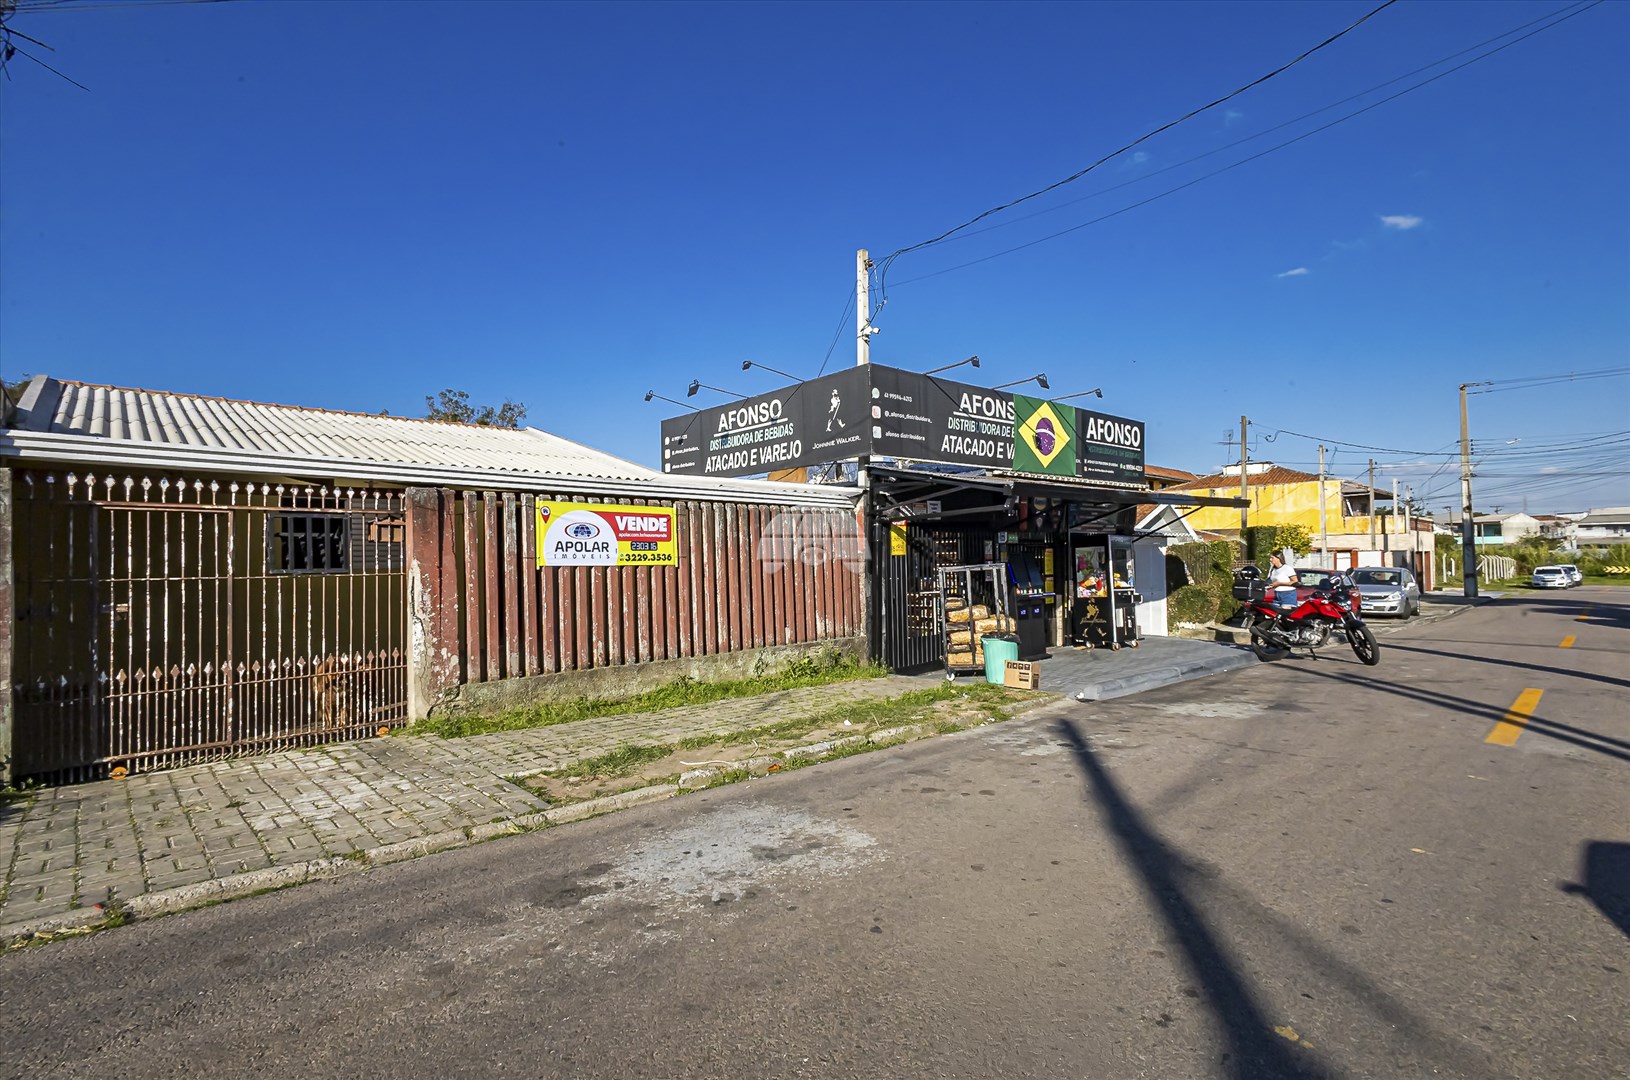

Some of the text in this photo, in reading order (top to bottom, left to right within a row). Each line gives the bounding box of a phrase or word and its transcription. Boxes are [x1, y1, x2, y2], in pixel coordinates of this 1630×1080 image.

[718, 399, 782, 432] AFONSO
[948, 416, 1000, 436] DISTRIBUIDORA
[1001, 425, 1011, 437] DE
[710, 432, 754, 451] DISTRIBUIDORA
[754, 429, 764, 443] DE
[764, 422, 794, 441] BEBIDAS
[1086, 417, 1140, 447] AFONSO
[704, 450, 749, 473] ATACADO
[750, 448, 758, 467] E
[759, 440, 802, 464] VAREJO
[941, 434, 995, 457] ATACADO
[996, 442, 1004, 458] E
[615, 515, 668, 533] VENDE
[554, 541, 610, 553] APOLAR
[625, 553, 672, 562] 3229.3536
